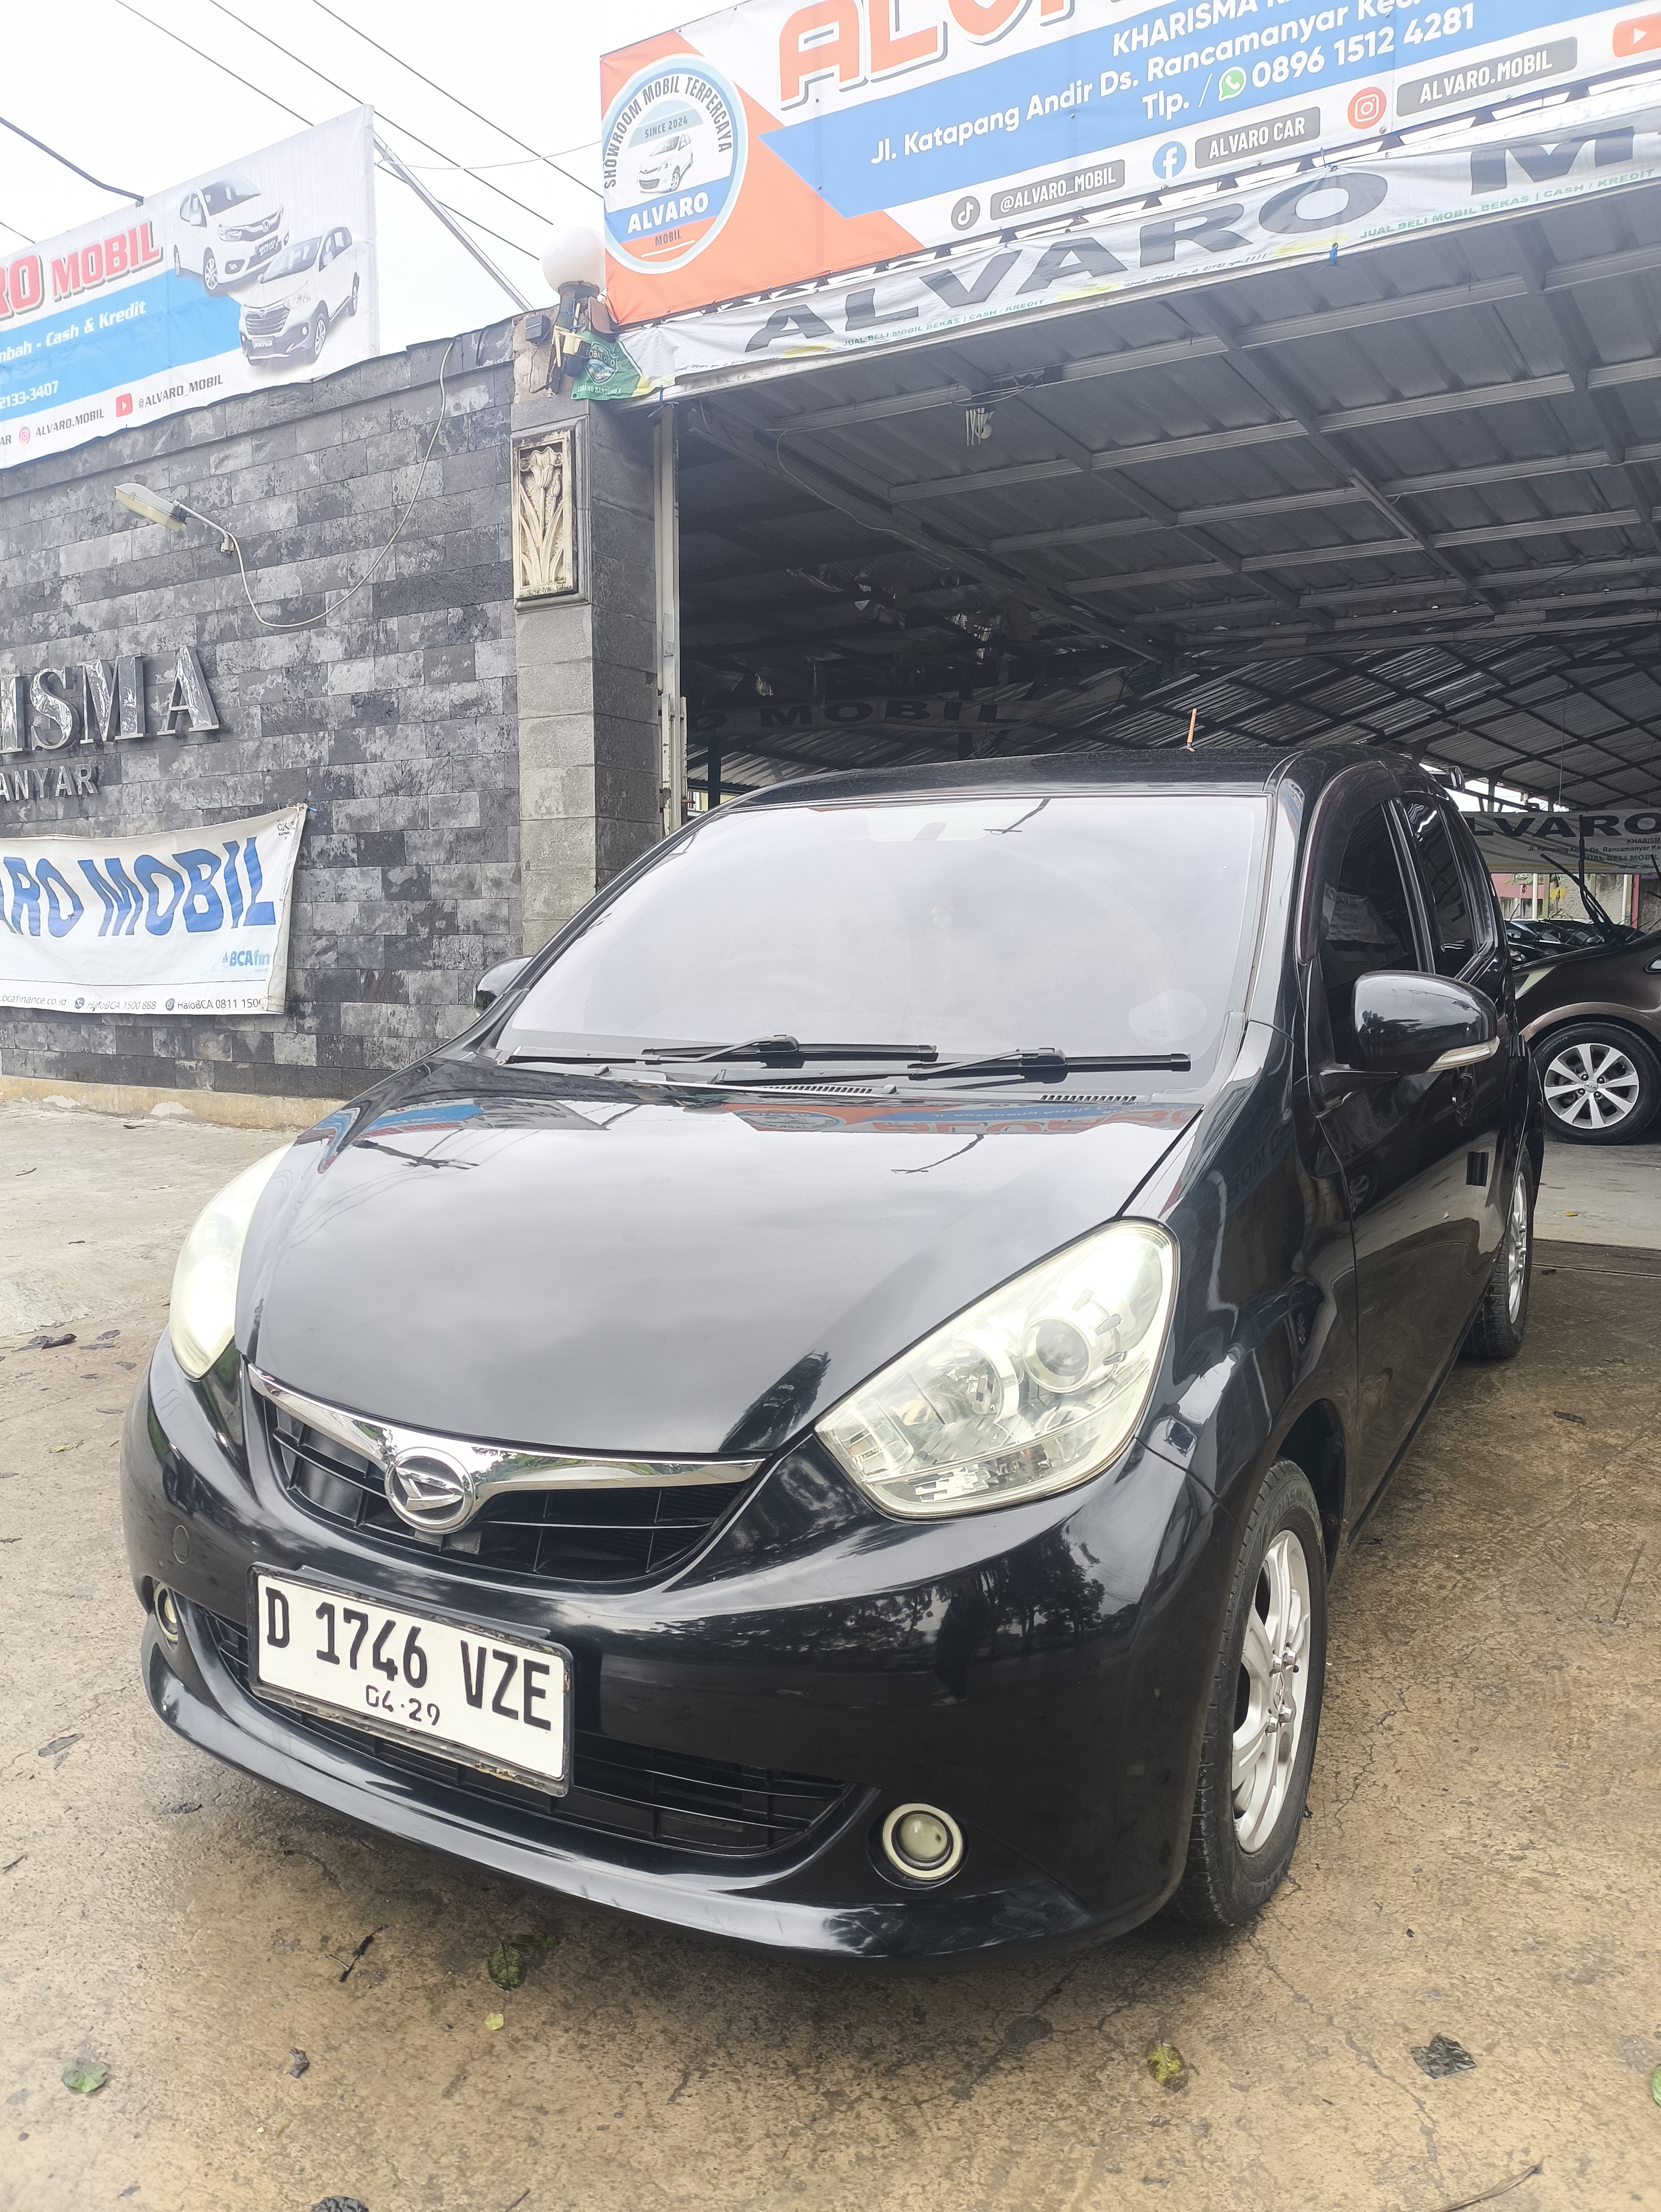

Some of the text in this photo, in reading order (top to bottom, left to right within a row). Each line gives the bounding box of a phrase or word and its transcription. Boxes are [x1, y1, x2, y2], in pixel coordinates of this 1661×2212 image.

[1113, 0, 1259, 56] KHARISMA
[871, 138, 897, 164] Jl.
[904, 107, 1020, 156] Katapang
[1026, 80, 1094, 120] Andir
[1100, 70, 1139, 97] Ds.
[1147, 6, 1349, 82] Rancamanyar
[1142, 91, 1190, 121] Tlp.
[1251, 46, 1325, 88] 0896
[1334, 26, 1395, 66] 1512
[1403, 2, 1474, 45] 4281
[1419, 50, 1553, 105] ALVARO.MOBIL
[604, 76, 732, 189] SHOWROOM MOBIL TERPERCAYA
[644, 116, 688, 139] SINCE 2024
[1208, 116, 1306, 160] ALVARO CAR
[627, 191, 709, 234] ALVARO
[1000, 166, 1117, 213] @ALVARO_MOBIL
[1360, 225, 1394, 239] JUAL
[1397, 217, 1428, 231] BELI
[1432, 207, 1477, 223] MOBIL
[1480, 195, 1529, 212] BEKAS
[1543, 184, 1584, 198] CASH
[1597, 168, 1655, 188] KREDIT
[51, 222, 162, 300] MOBIL
[654, 229, 682, 247] MOBIL
[744, 172, 1388, 353] ALVARO
[45, 324, 79, 347] Cash
[84, 318, 95, 334] &
[99, 300, 147, 329] Kredit
[842, 337, 865, 347] JUAL
[867, 332, 889, 342] BELI
[892, 326, 923, 337] MOBIL
[926, 318, 960, 330] BEKAS
[969, 309, 997, 320] CASH
[1005, 299, 1046, 312] KREDIT
[604, 355, 615, 367] OTO
[138, 374, 224, 409] @ALVARO_MOBIL
[35, 409, 105, 438] ALVARO.MOBIL
[759, 701, 1023, 727] MOBIL
[77, 836, 277, 937] MOBIL
[123, 1001, 141, 1010] 1500
[142, 1001, 156, 1010] 888
[177, 999, 214, 1009] HaloBCA
[215, 999, 237, 1009] 0811
[265, 1586, 552, 1731] D 1746 VZE
